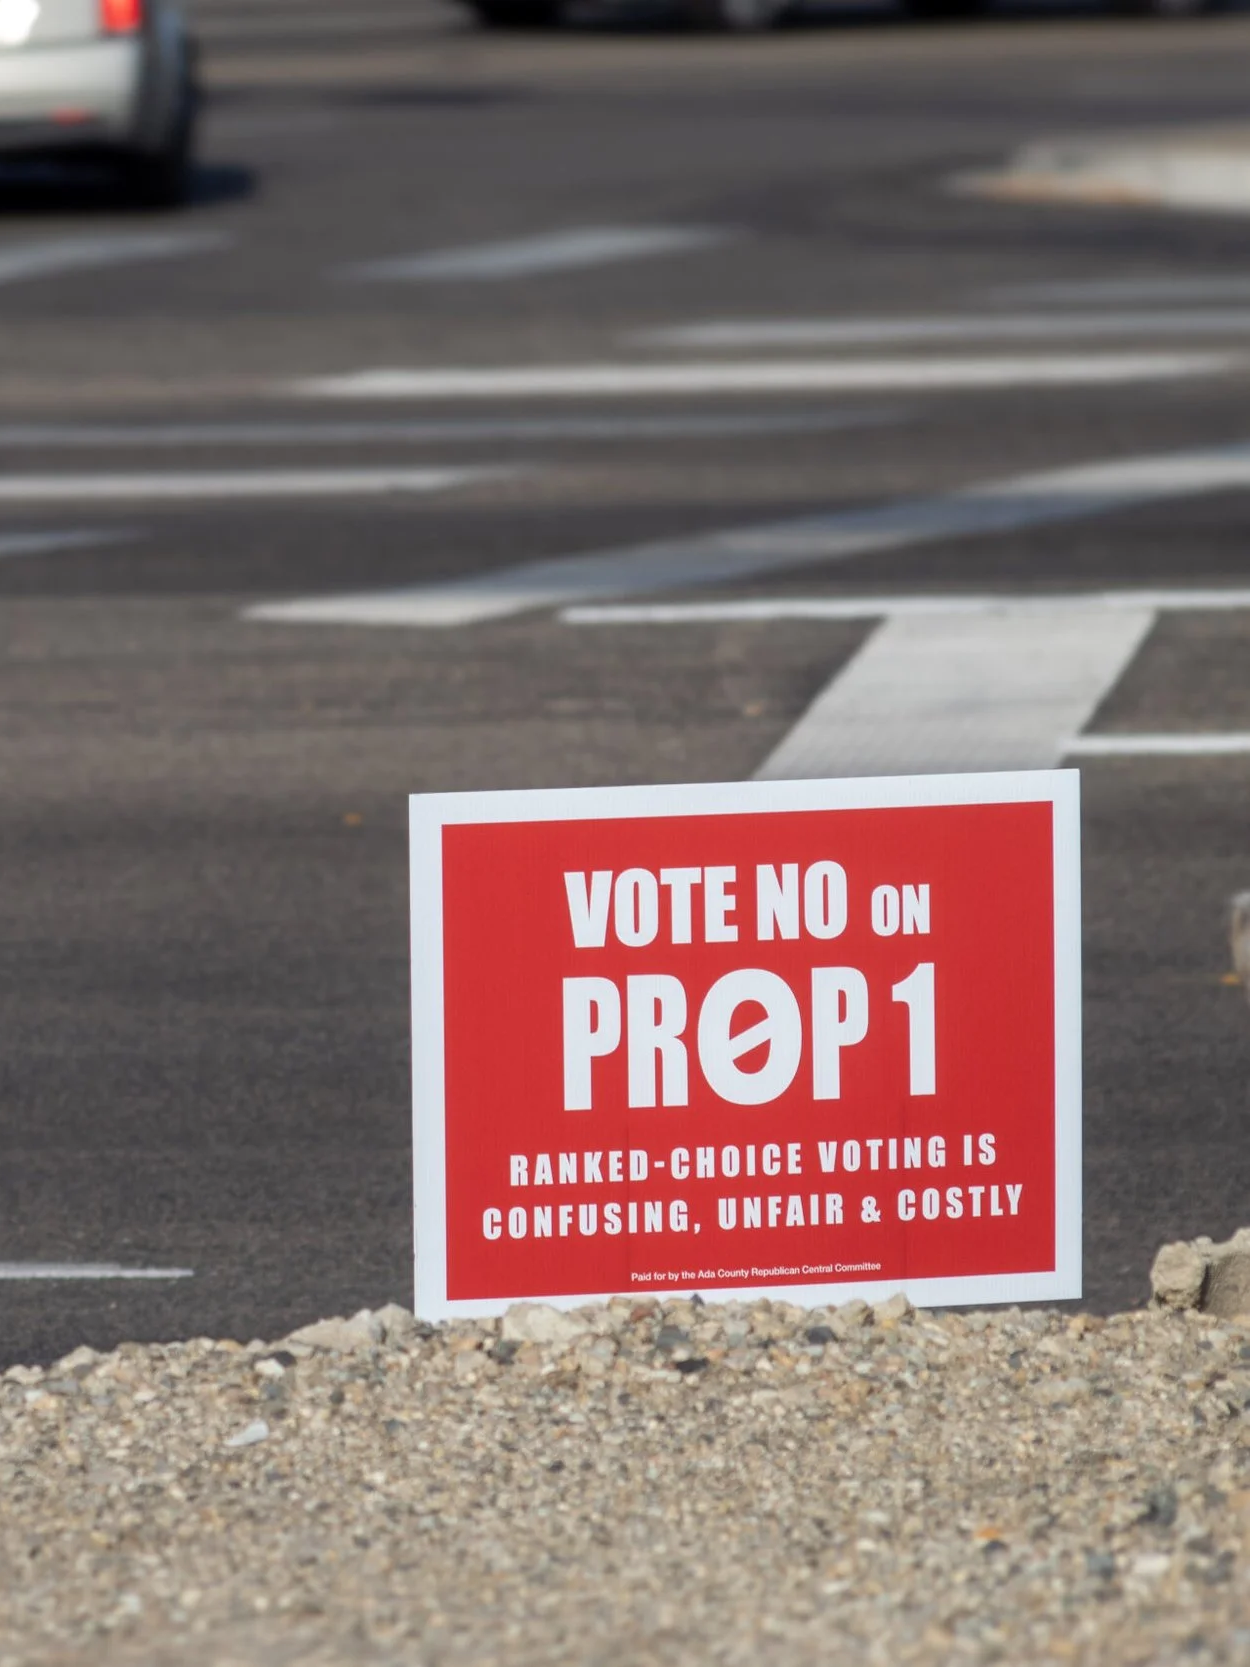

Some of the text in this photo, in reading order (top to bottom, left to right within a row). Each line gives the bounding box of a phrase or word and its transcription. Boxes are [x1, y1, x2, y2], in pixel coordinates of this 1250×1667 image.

[563, 860, 931, 948] VOTE NO ON
[562, 962, 937, 1111] PROP 1
[509, 1133, 997, 1187] RANKED-CHOICE VOTING IS
[482, 1184, 1023, 1240] CONFUSING, UNFAIR & COSTLY
[631, 1262, 882, 1282] Paid for by the Ada County Republican Central Committee
